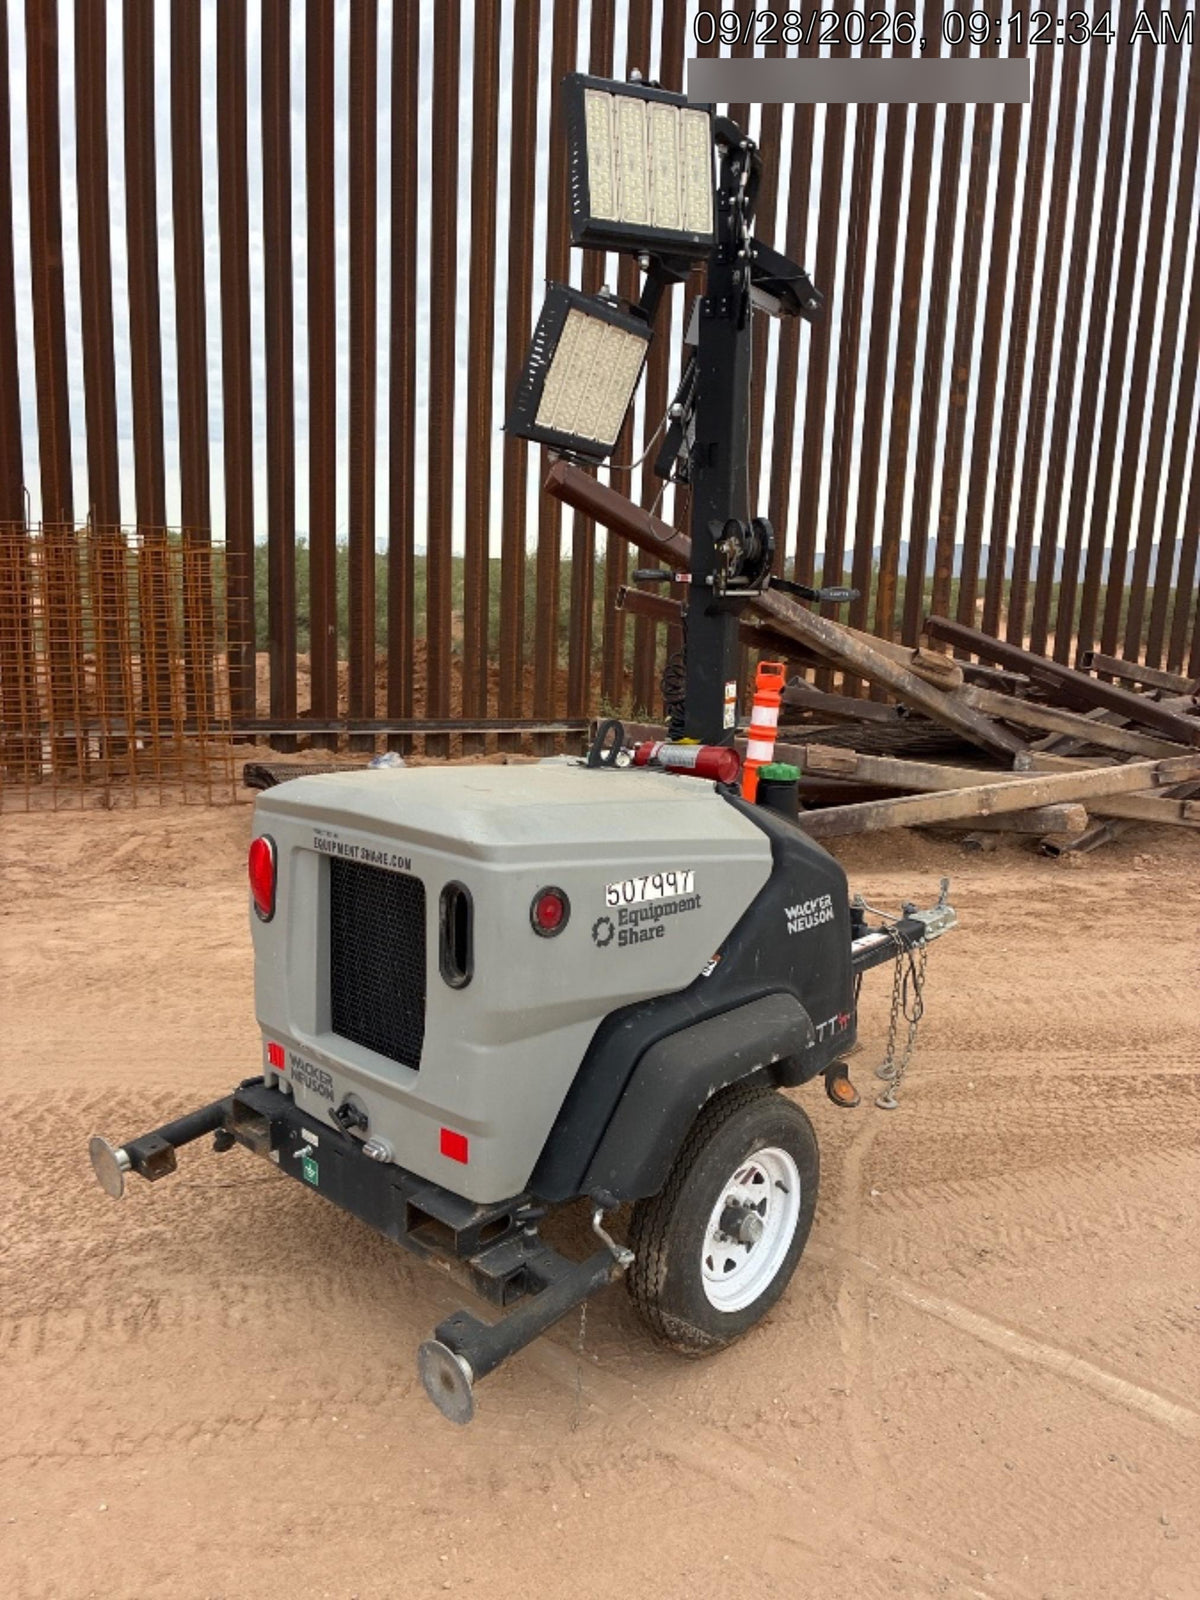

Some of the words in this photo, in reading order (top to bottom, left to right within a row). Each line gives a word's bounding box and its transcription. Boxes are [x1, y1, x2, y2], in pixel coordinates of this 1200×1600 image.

[607, 869, 692, 906] 507997
[618, 894, 702, 927] Equipment
[784, 894, 832, 920] WACKER
[787, 906, 834, 935] NEUSON
[618, 924, 664, 946] Share
[289, 1052, 333, 1089] WACKER
